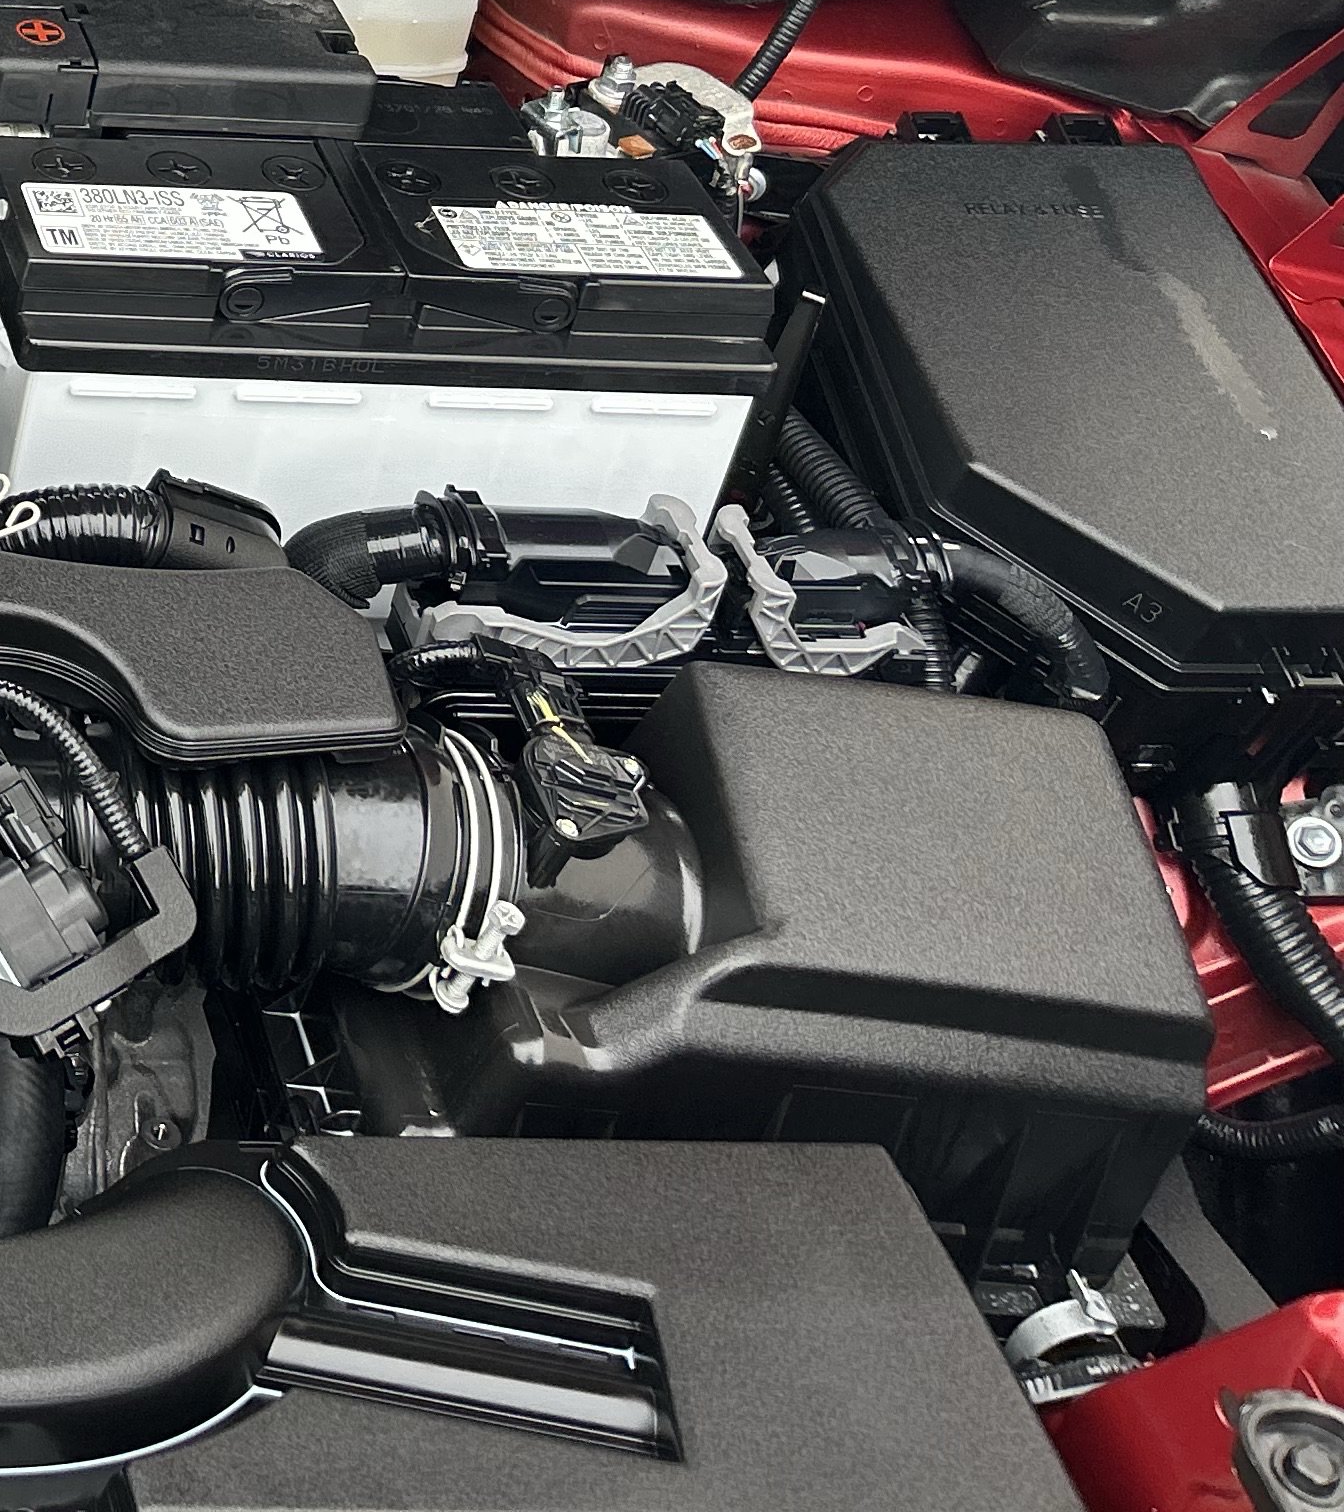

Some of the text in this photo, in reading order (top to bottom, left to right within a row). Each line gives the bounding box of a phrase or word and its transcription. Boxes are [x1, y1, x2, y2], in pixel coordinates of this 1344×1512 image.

[79, 188, 185, 207] 380LN3-ISS
[964, 202, 1025, 216] RELAY
[1050, 203, 1105, 219] FUSE
[46, 228, 79, 245] TM
[265, 234, 290, 245] Pb
[1122, 593, 1163, 623] A3
